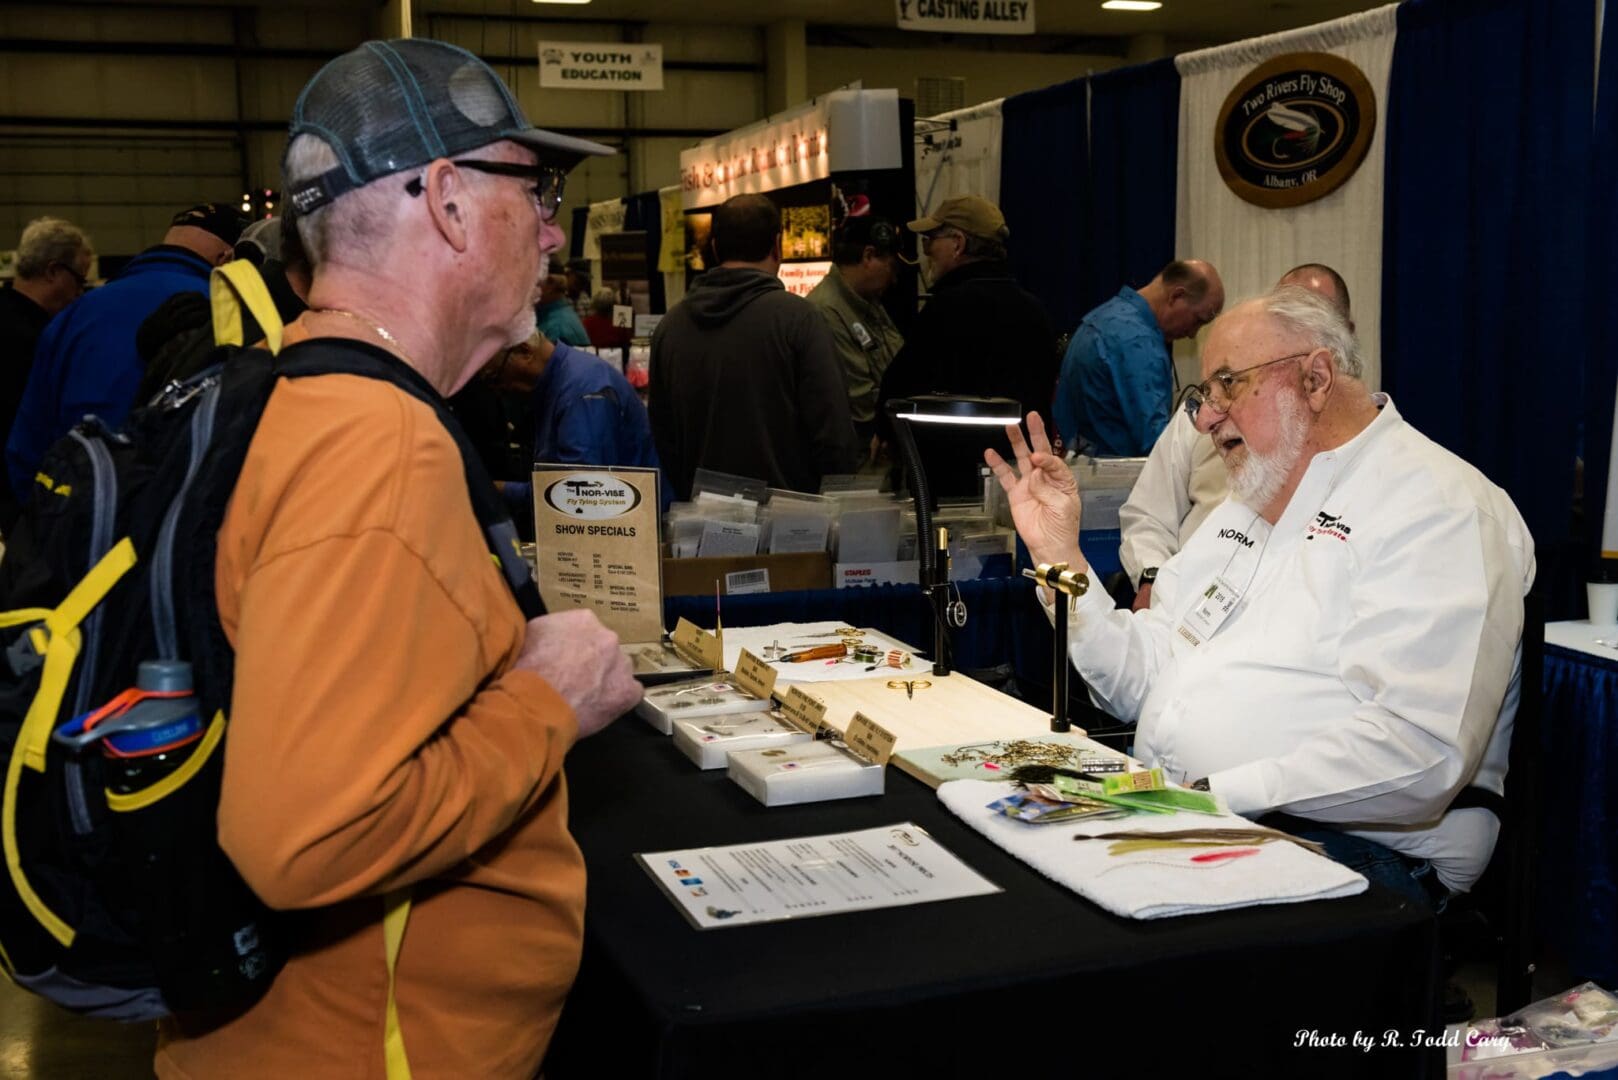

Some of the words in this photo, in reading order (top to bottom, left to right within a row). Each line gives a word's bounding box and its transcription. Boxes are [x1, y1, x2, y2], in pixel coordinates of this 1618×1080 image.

[918, 0, 979, 20] CASTING
[983, 1, 1028, 21] ALLEY
[570, 52, 632, 64] YOUTH
[561, 69, 642, 81] EDUCATION
[1242, 94, 1265, 116] Two
[1266, 79, 1299, 101] Rivers
[1300, 74, 1317, 95] Fly
[1318, 76, 1346, 104] Shop
[1263, 174, 1299, 189] Albany,
[1301, 169, 1318, 184] OR
[555, 524, 585, 535] SHOW
[587, 526, 637, 537] SPECIALS
[1217, 528, 1255, 549] NORM
